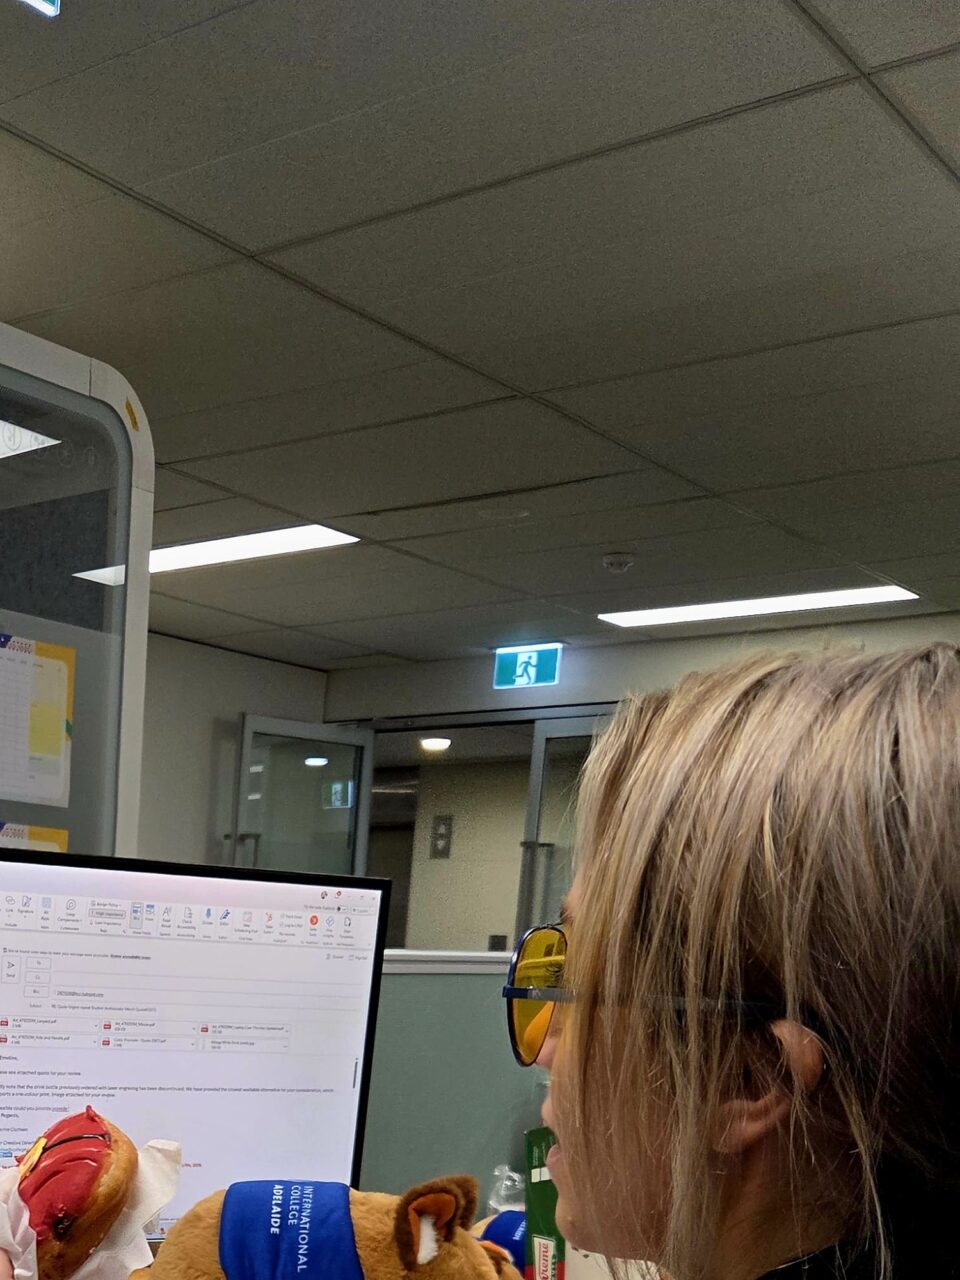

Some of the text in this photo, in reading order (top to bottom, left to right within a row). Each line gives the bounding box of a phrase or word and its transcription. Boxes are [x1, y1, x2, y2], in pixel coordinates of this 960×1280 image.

[270, 1184, 284, 1235] ADELAIDE
[287, 1184, 301, 1226] COLLEGE
[297, 1185, 314, 1273] INTERNATIONAL
